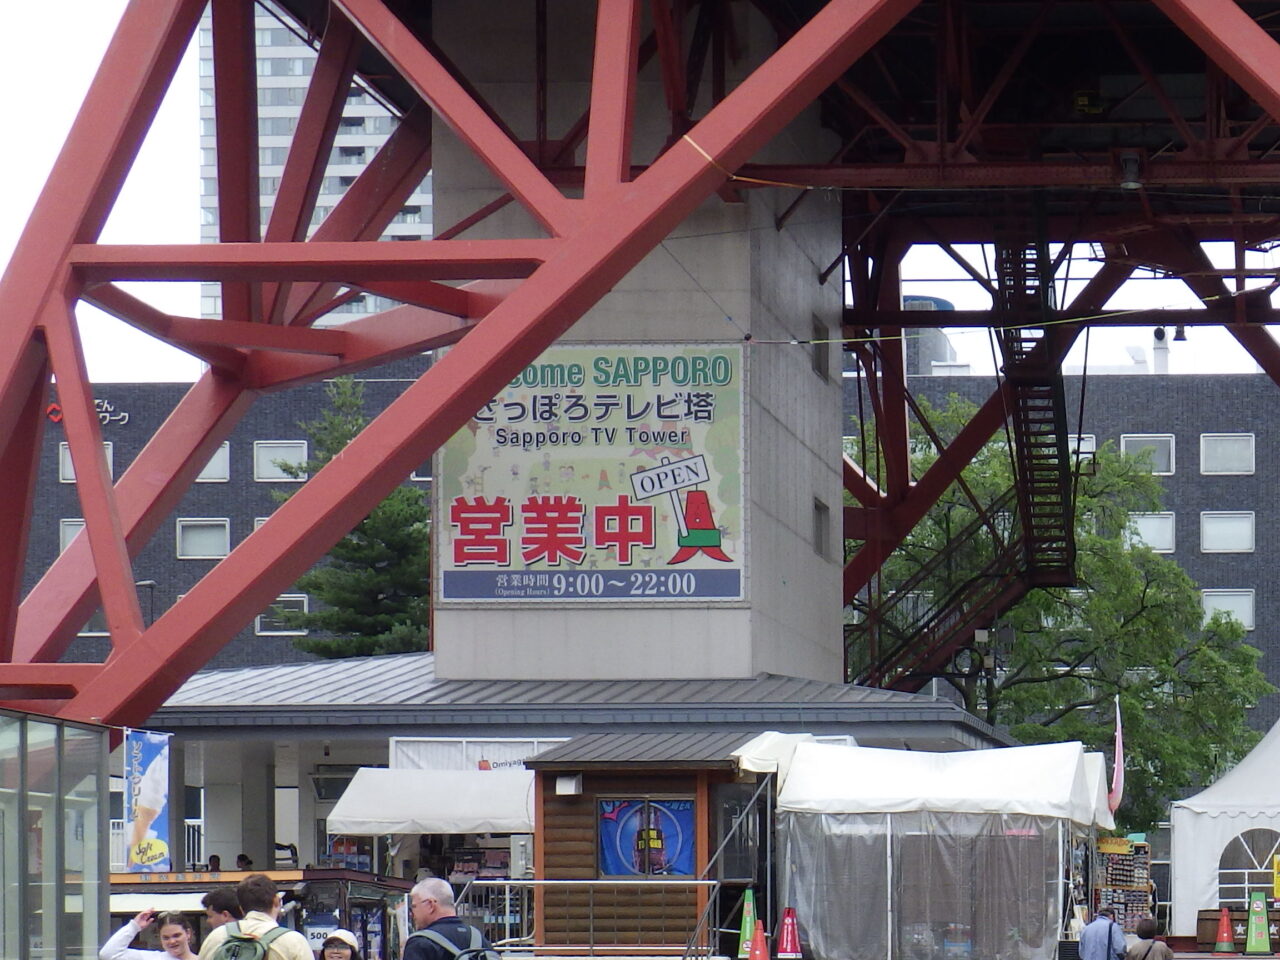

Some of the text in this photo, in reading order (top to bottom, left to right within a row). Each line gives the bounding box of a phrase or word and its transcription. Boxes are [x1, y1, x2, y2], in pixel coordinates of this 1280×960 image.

[593, 355, 731, 386] SAPPORO
[495, 427, 689, 448] Sapporo TV Tower
[640, 462, 701, 495] OPEN
[450, 494, 656, 564] 営業中
[496, 574, 548, 587] 営業時間
[310, 931, 329, 940] 500
